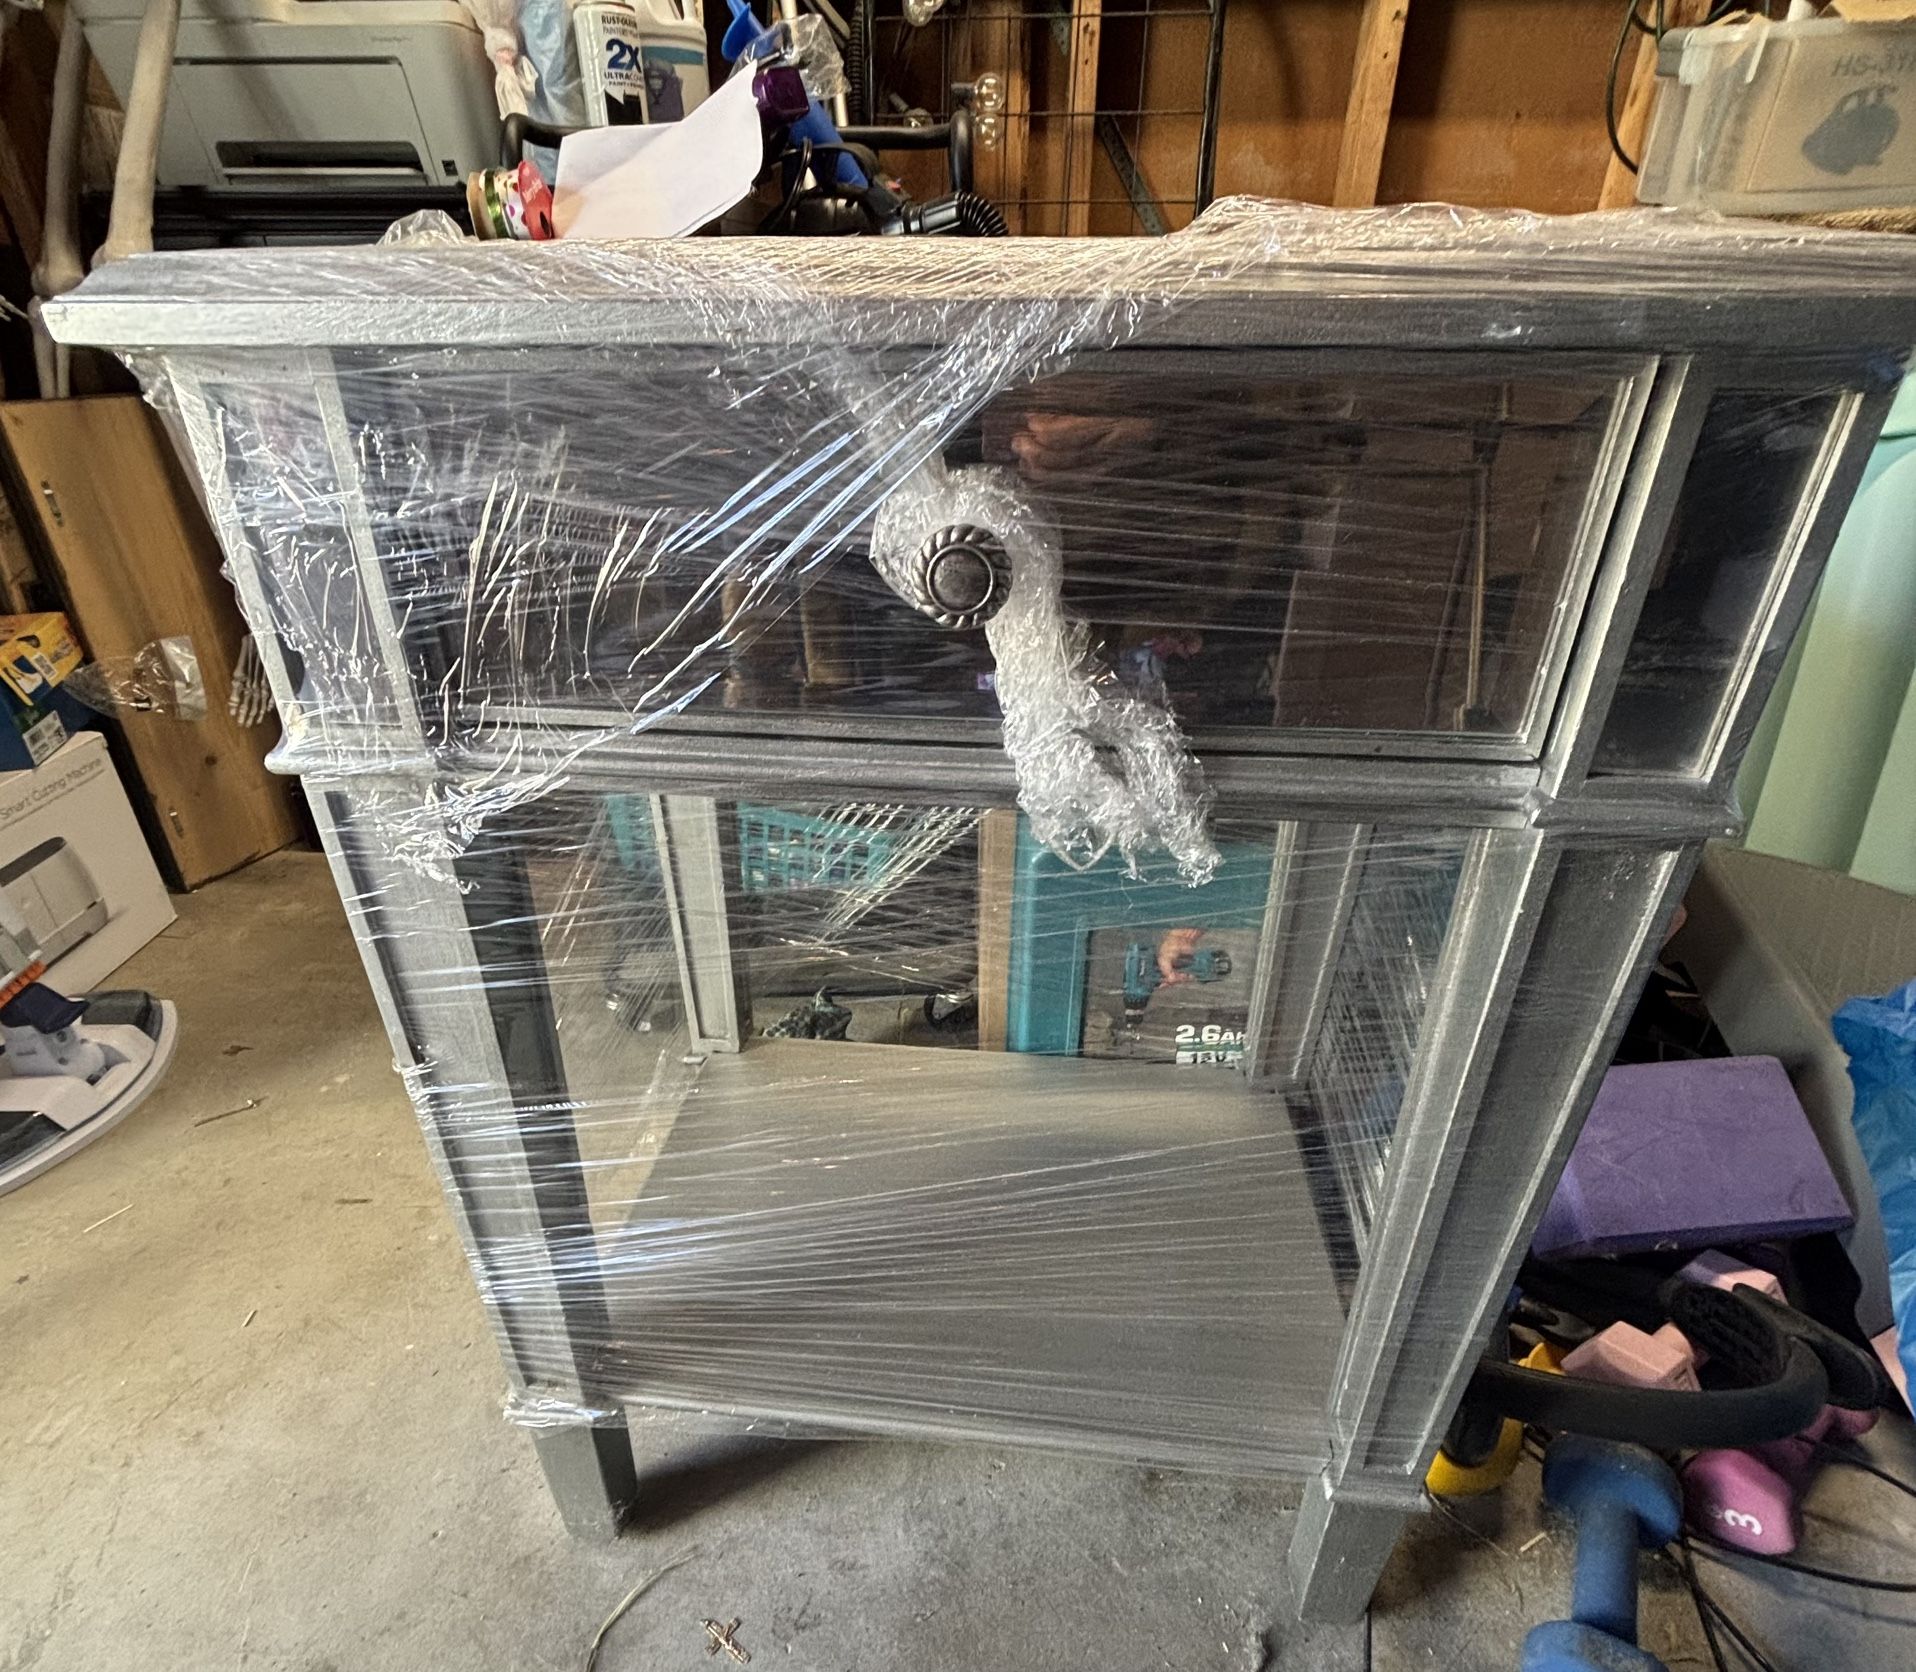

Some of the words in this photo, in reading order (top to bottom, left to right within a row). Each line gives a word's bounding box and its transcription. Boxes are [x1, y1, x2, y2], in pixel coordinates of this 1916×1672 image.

[606, 38, 642, 73] 2X
[0, 797, 32, 820] Smart
[32, 779, 66, 801] Cutting
[66, 758, 101, 780] Machine
[1724, 1509, 1762, 1535] 3
